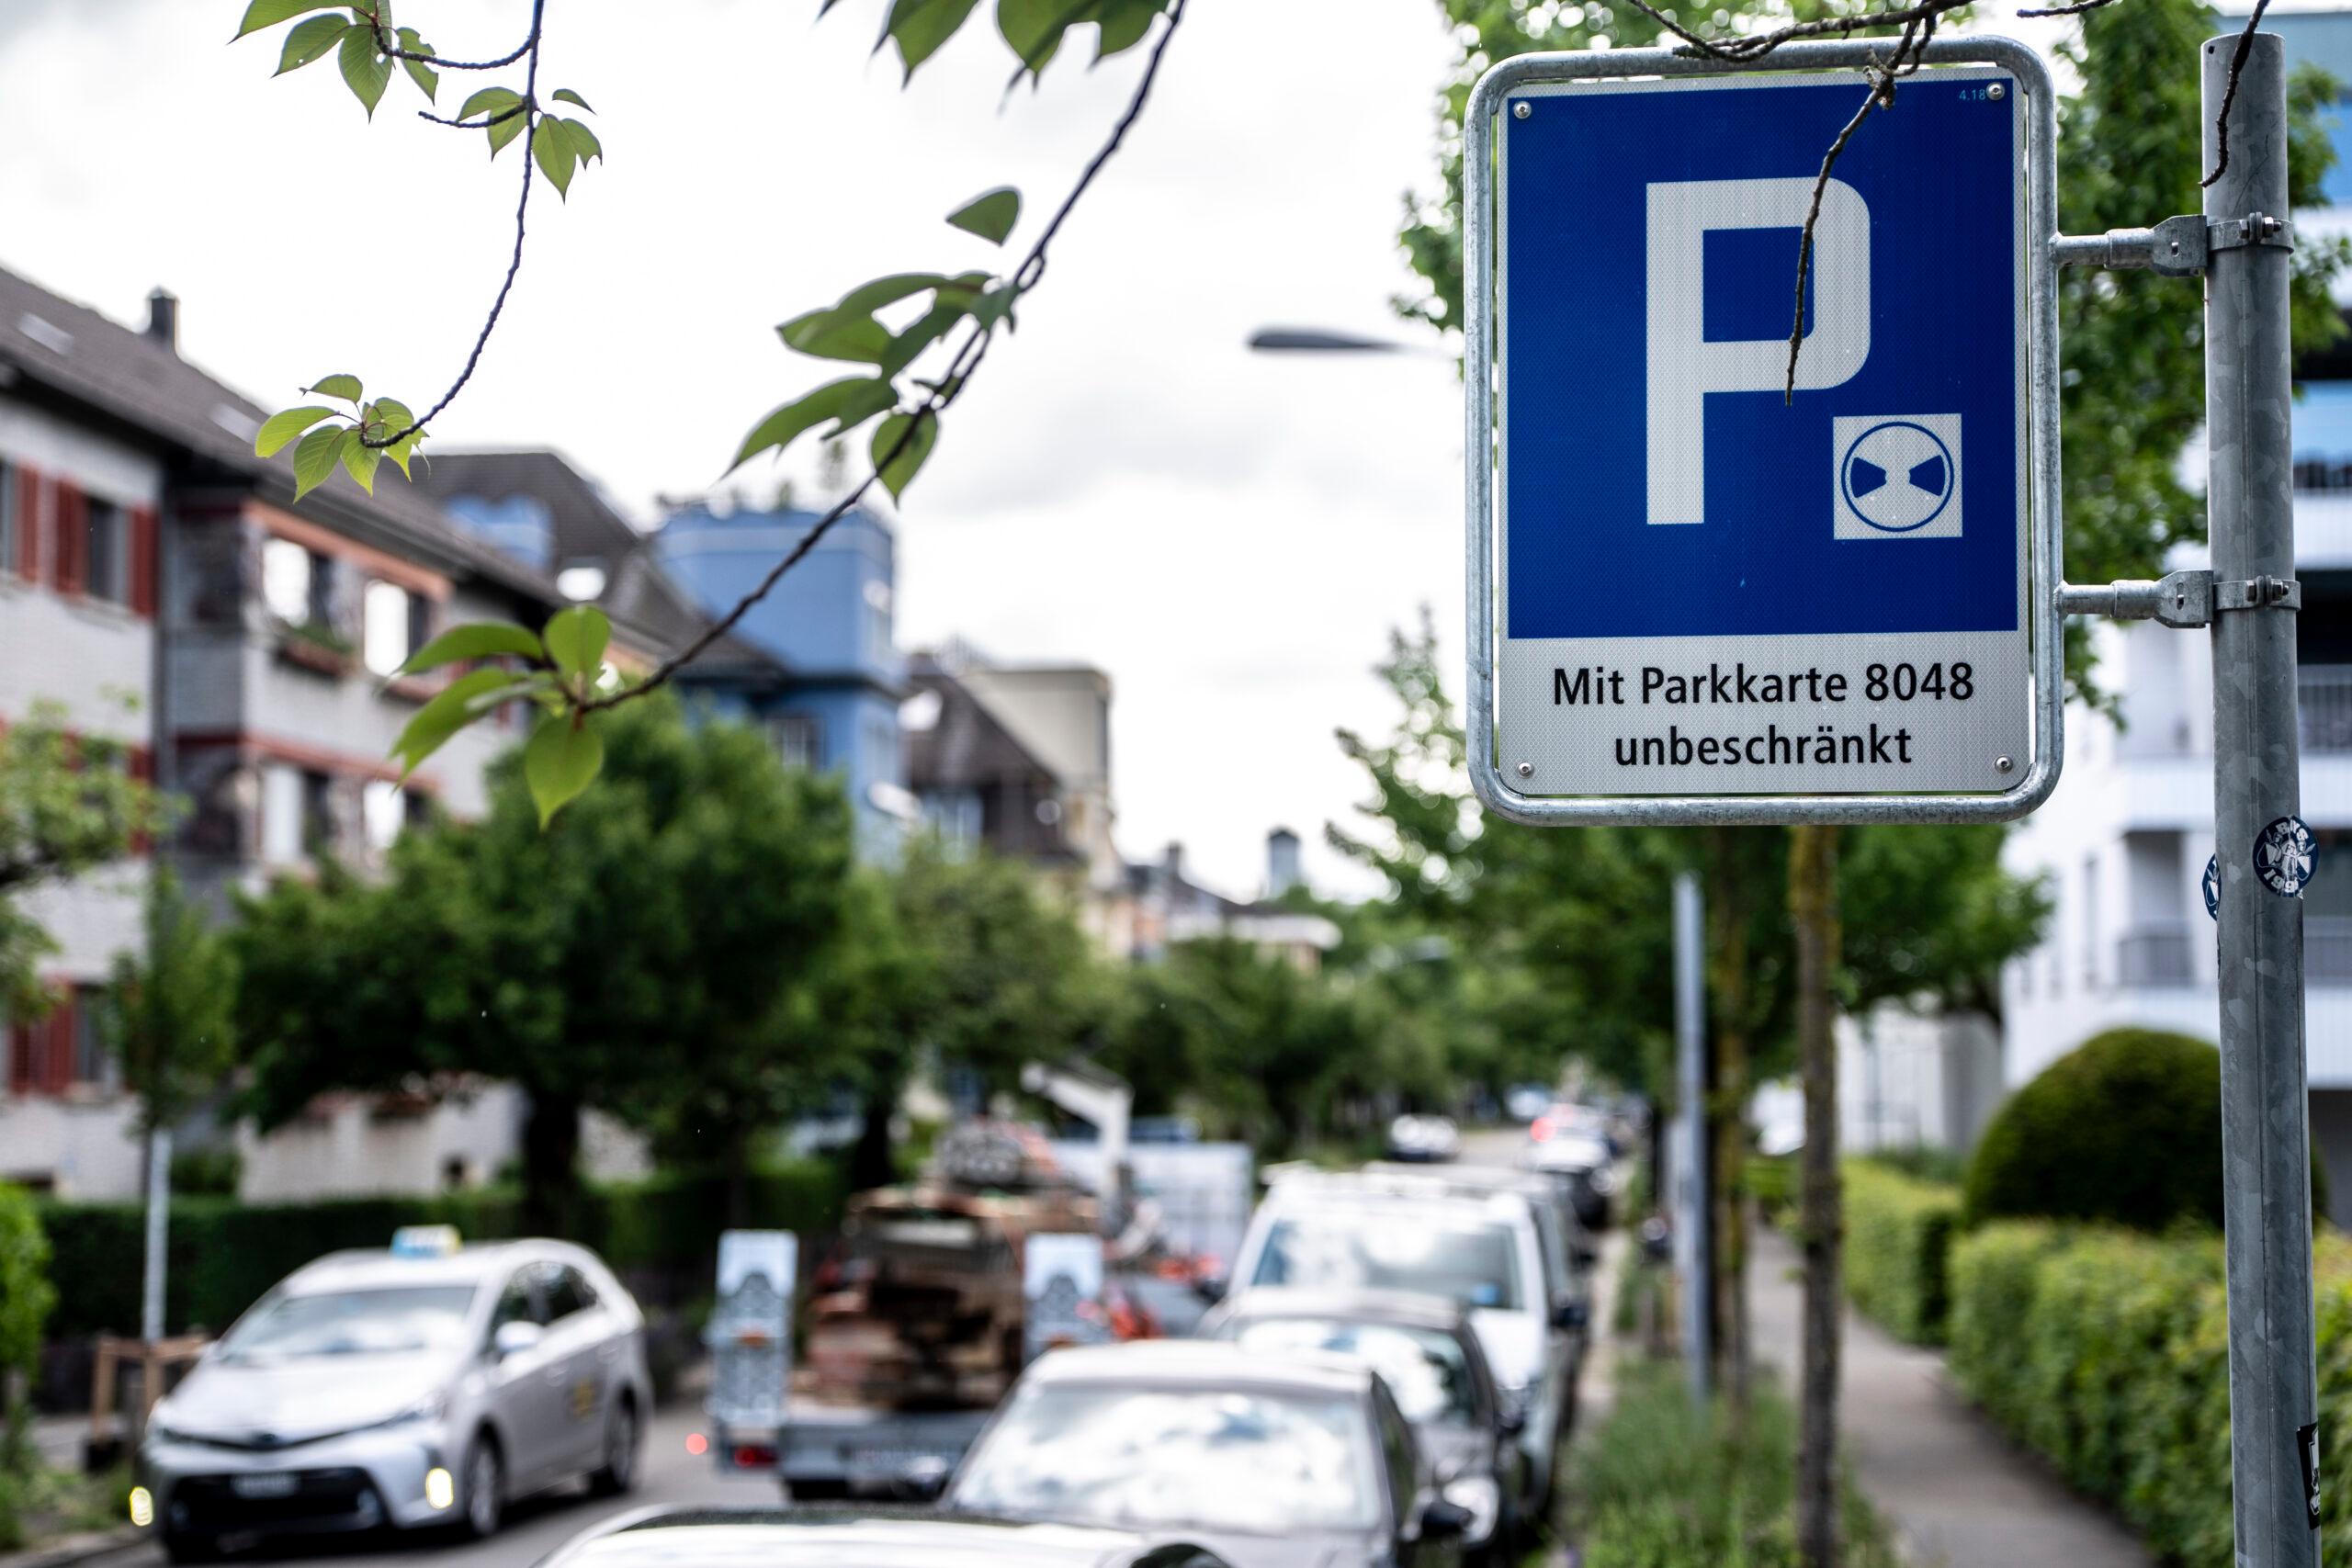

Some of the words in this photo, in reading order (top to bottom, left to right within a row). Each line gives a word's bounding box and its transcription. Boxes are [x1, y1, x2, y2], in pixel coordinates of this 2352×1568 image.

[1959, 89, 1986, 100] 4.18
[1645, 176, 1871, 525] P
[1554, 667, 1624, 705] Mit
[1642, 662, 1848, 705] Parkkarte
[1864, 661, 1974, 703] 8048
[1615, 723, 1913, 767] unbeschränkt
